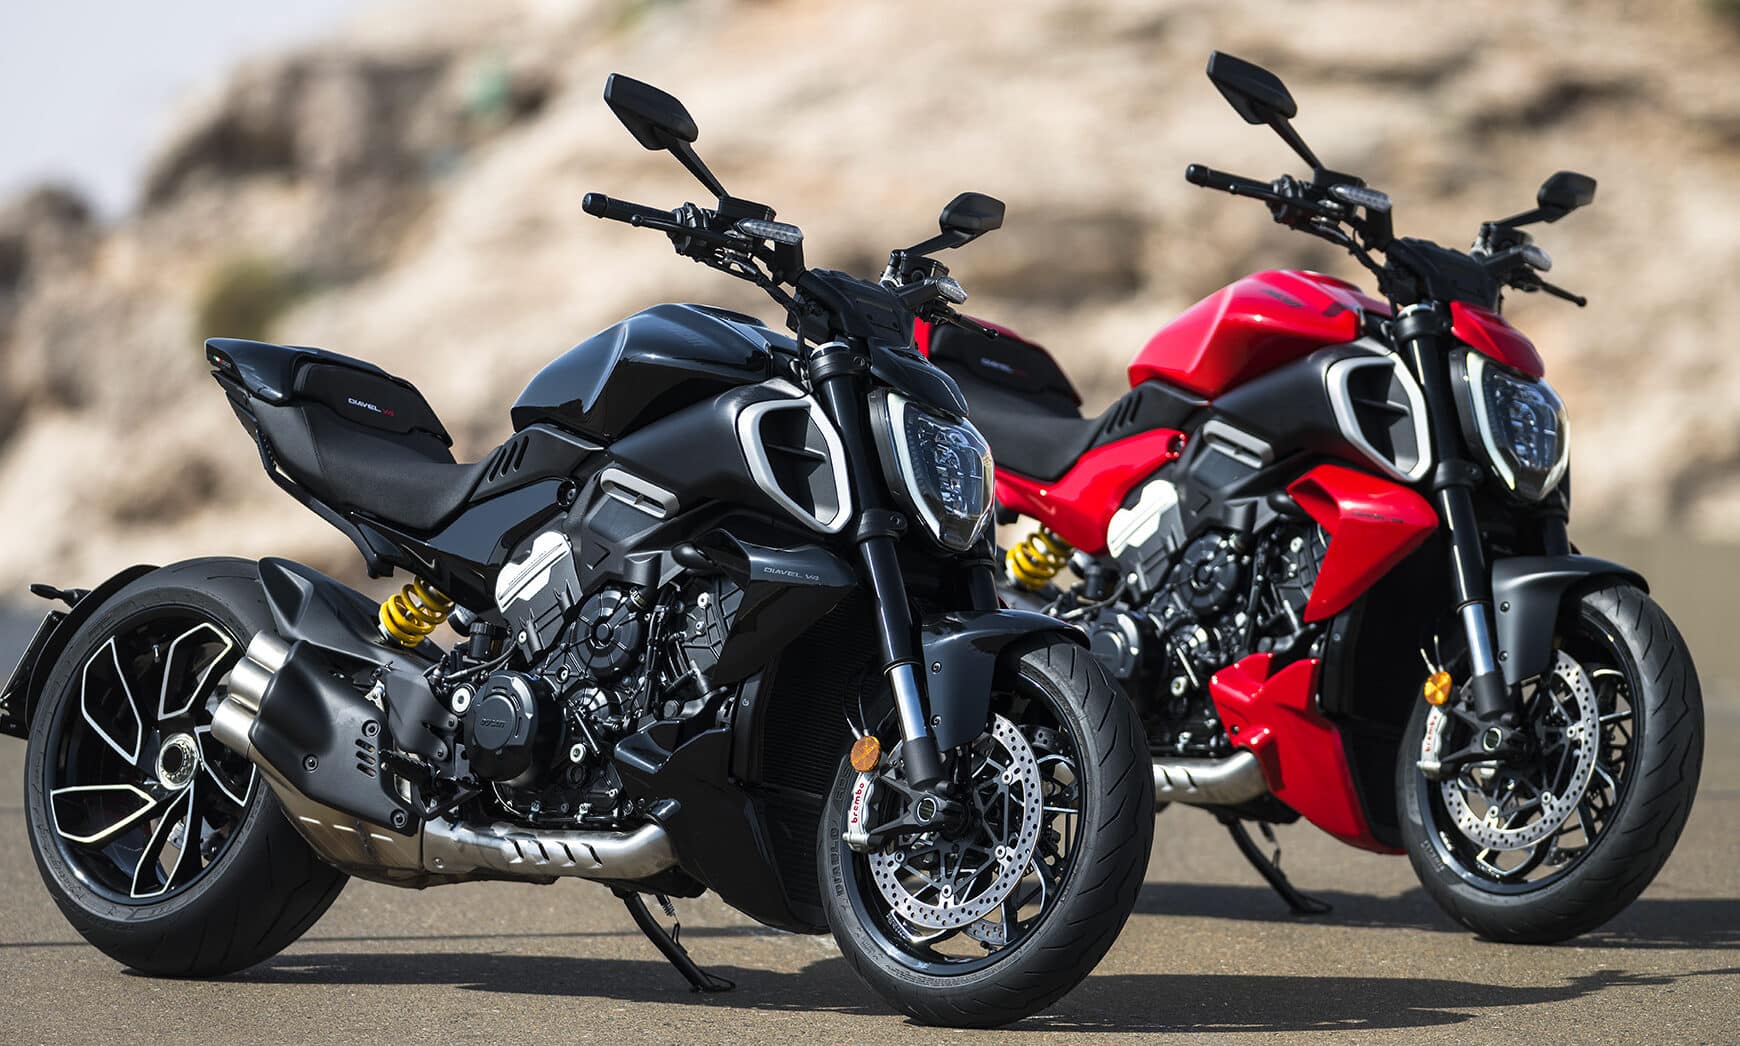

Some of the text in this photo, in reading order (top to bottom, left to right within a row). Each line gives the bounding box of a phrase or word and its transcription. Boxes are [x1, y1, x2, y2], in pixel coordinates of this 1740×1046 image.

[347, 397, 382, 413] DIAVEL
[763, 566, 803, 578] DIAVEL
[851, 782, 865, 824] brembo
